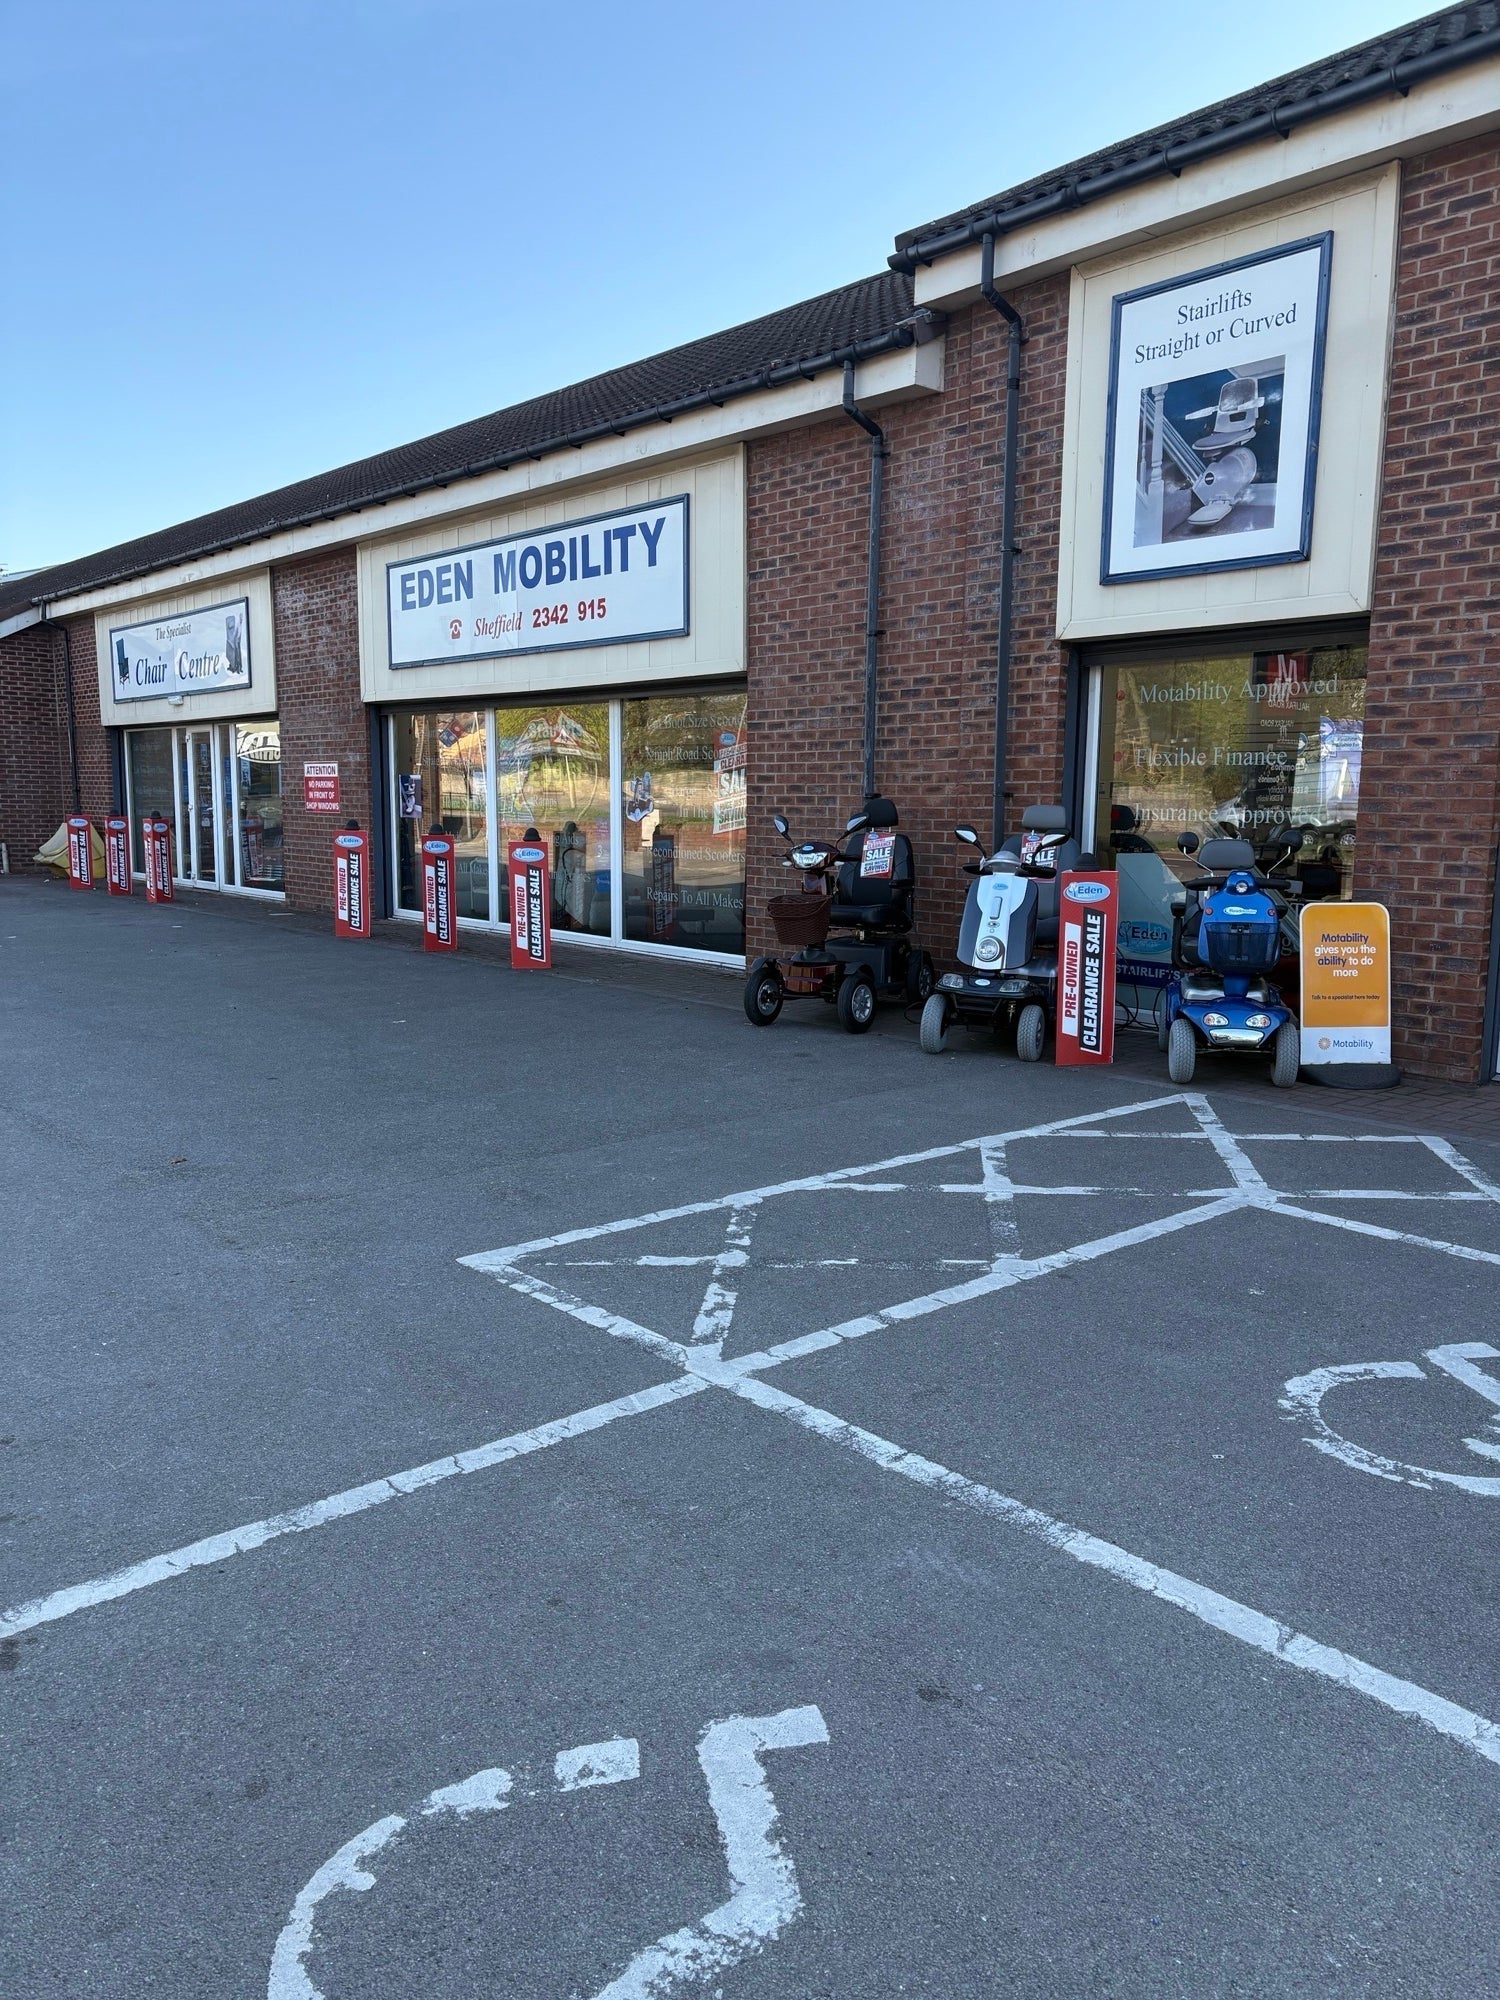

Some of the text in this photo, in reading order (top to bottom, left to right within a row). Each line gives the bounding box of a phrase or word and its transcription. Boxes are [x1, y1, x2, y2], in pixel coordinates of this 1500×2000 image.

[1178, 289, 1252, 325] Stairlifts
[1135, 302, 1297, 363] Straight or Curved
[401, 517, 666, 611] EDEN MOBILITY
[474, 598, 606, 639] Sheffield 2342 915
[155, 622, 192, 641] The Specialist
[136, 651, 219, 686] Chair Centre
[1140, 673, 1338, 705] Motability Approved
[677, 746, 699, 761] Road
[1136, 747, 1288, 767] Flexible Finance
[306, 766, 336, 775] ATTENTION
[308, 780, 335, 789] NO PARKING
[308, 791, 335, 800] IN FRONT OF
[306, 801, 340, 811] SHOP WINDOWS
[1134, 803, 1219, 822] Insurance
[79, 847, 88, 882] CLEARANCE
[704, 847, 745, 863] Scooters
[867, 847, 891, 860] SALE
[118, 850, 126, 888] CLEARANCE
[339, 868, 347, 911] PRE-OWNED
[350, 853, 360, 927] CLEARANCE SALE
[428, 876, 436, 923] PRE-OWNED
[437, 860, 447, 940] CLEARANCE SALE
[647, 886, 743, 910] Repairs To All Makes
[1078, 886, 1102, 894] Eden
[516, 886, 526, 938] PRE-OWNED
[530, 869, 542, 957] CLEARANCE SALE
[1086, 914, 1101, 955] SALE
[1131, 926, 1168, 942] Eden
[1321, 933, 1369, 945] Motability
[1314, 944, 1376, 957] gives you the
[1317, 956, 1374, 967] ability to do
[1065, 940, 1078, 1019] PRE-OWNED
[1333, 968, 1359, 977] more
[1083, 957, 1100, 1047] CLEARANCE
[1333, 1039, 1374, 1050] Motability
